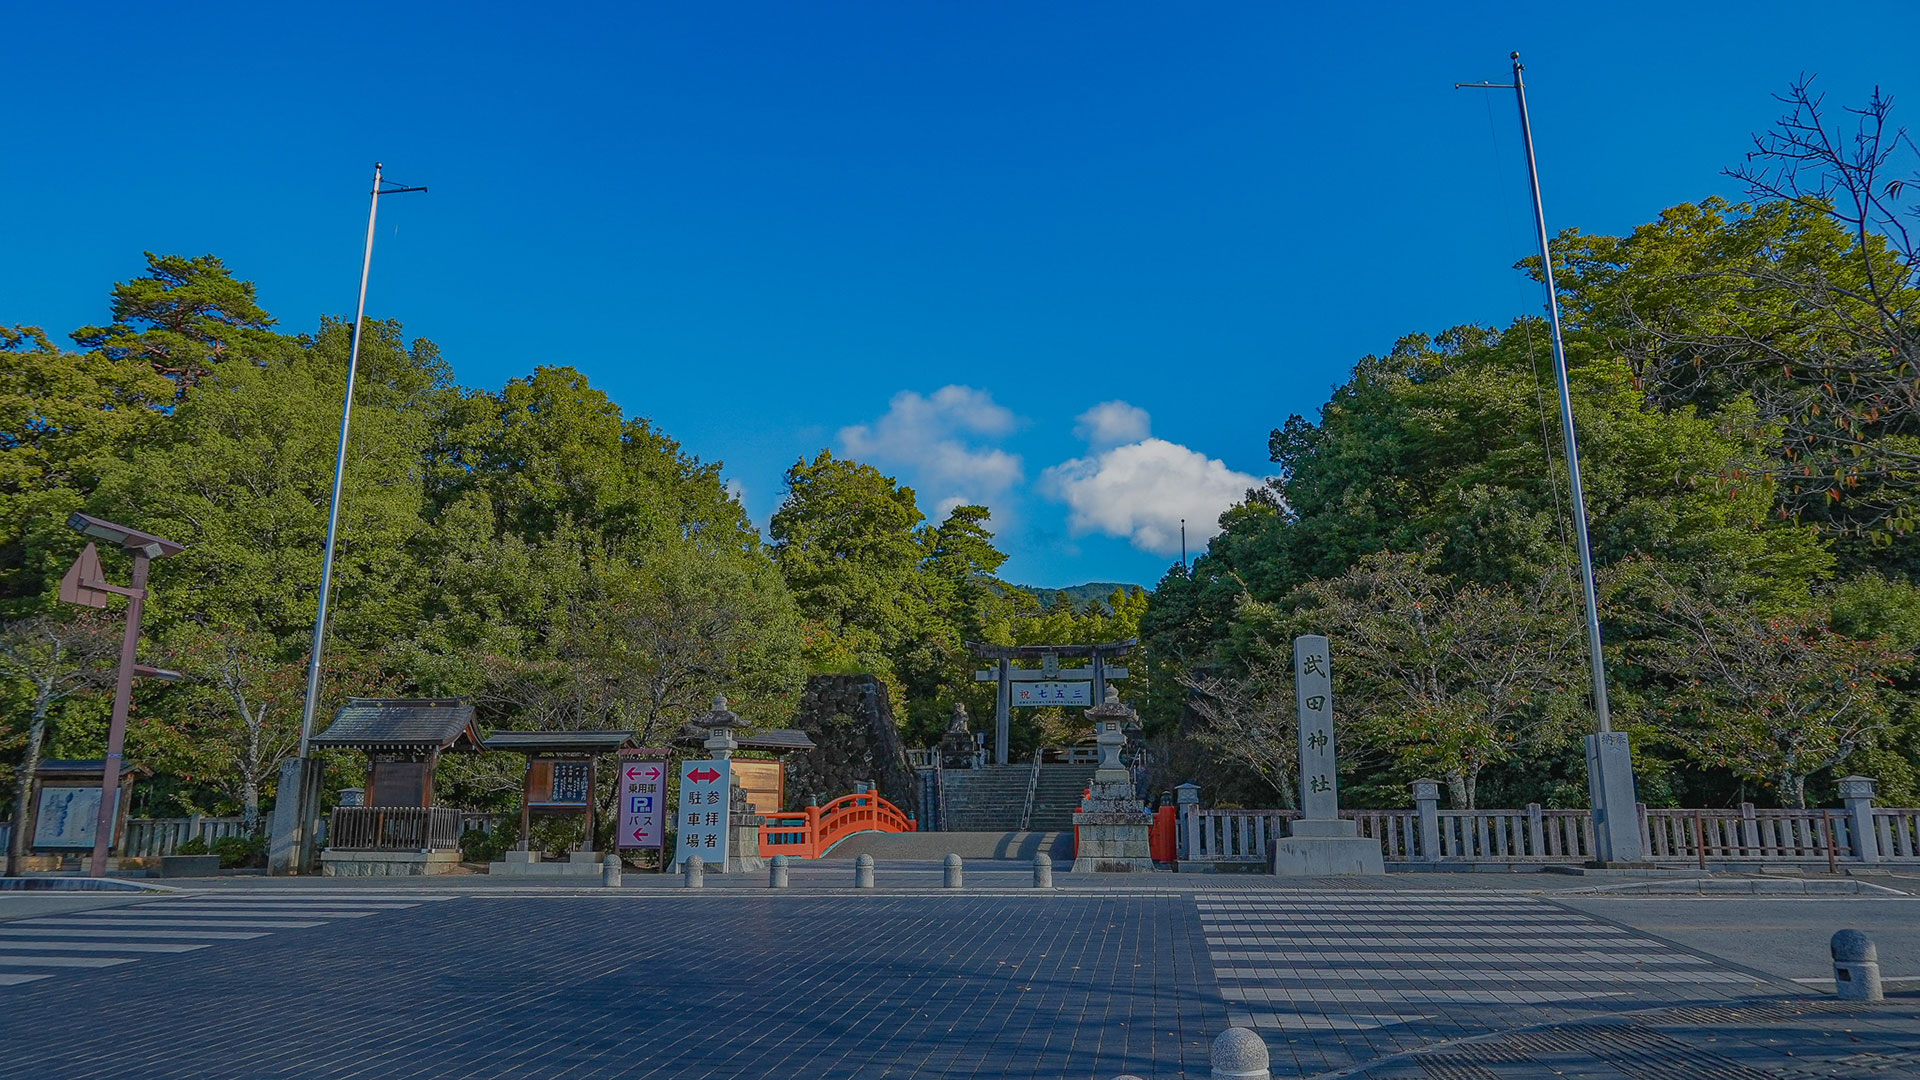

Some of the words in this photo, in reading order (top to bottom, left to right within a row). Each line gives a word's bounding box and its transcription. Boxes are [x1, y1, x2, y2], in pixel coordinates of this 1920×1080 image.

[1303, 654, 1332, 794] 武田神社
[628, 783, 657, 794] 乗用車
[629, 815, 653, 826] バス
[685, 791, 702, 848] 駐車場
[704, 790, 720, 848] 参拝者
